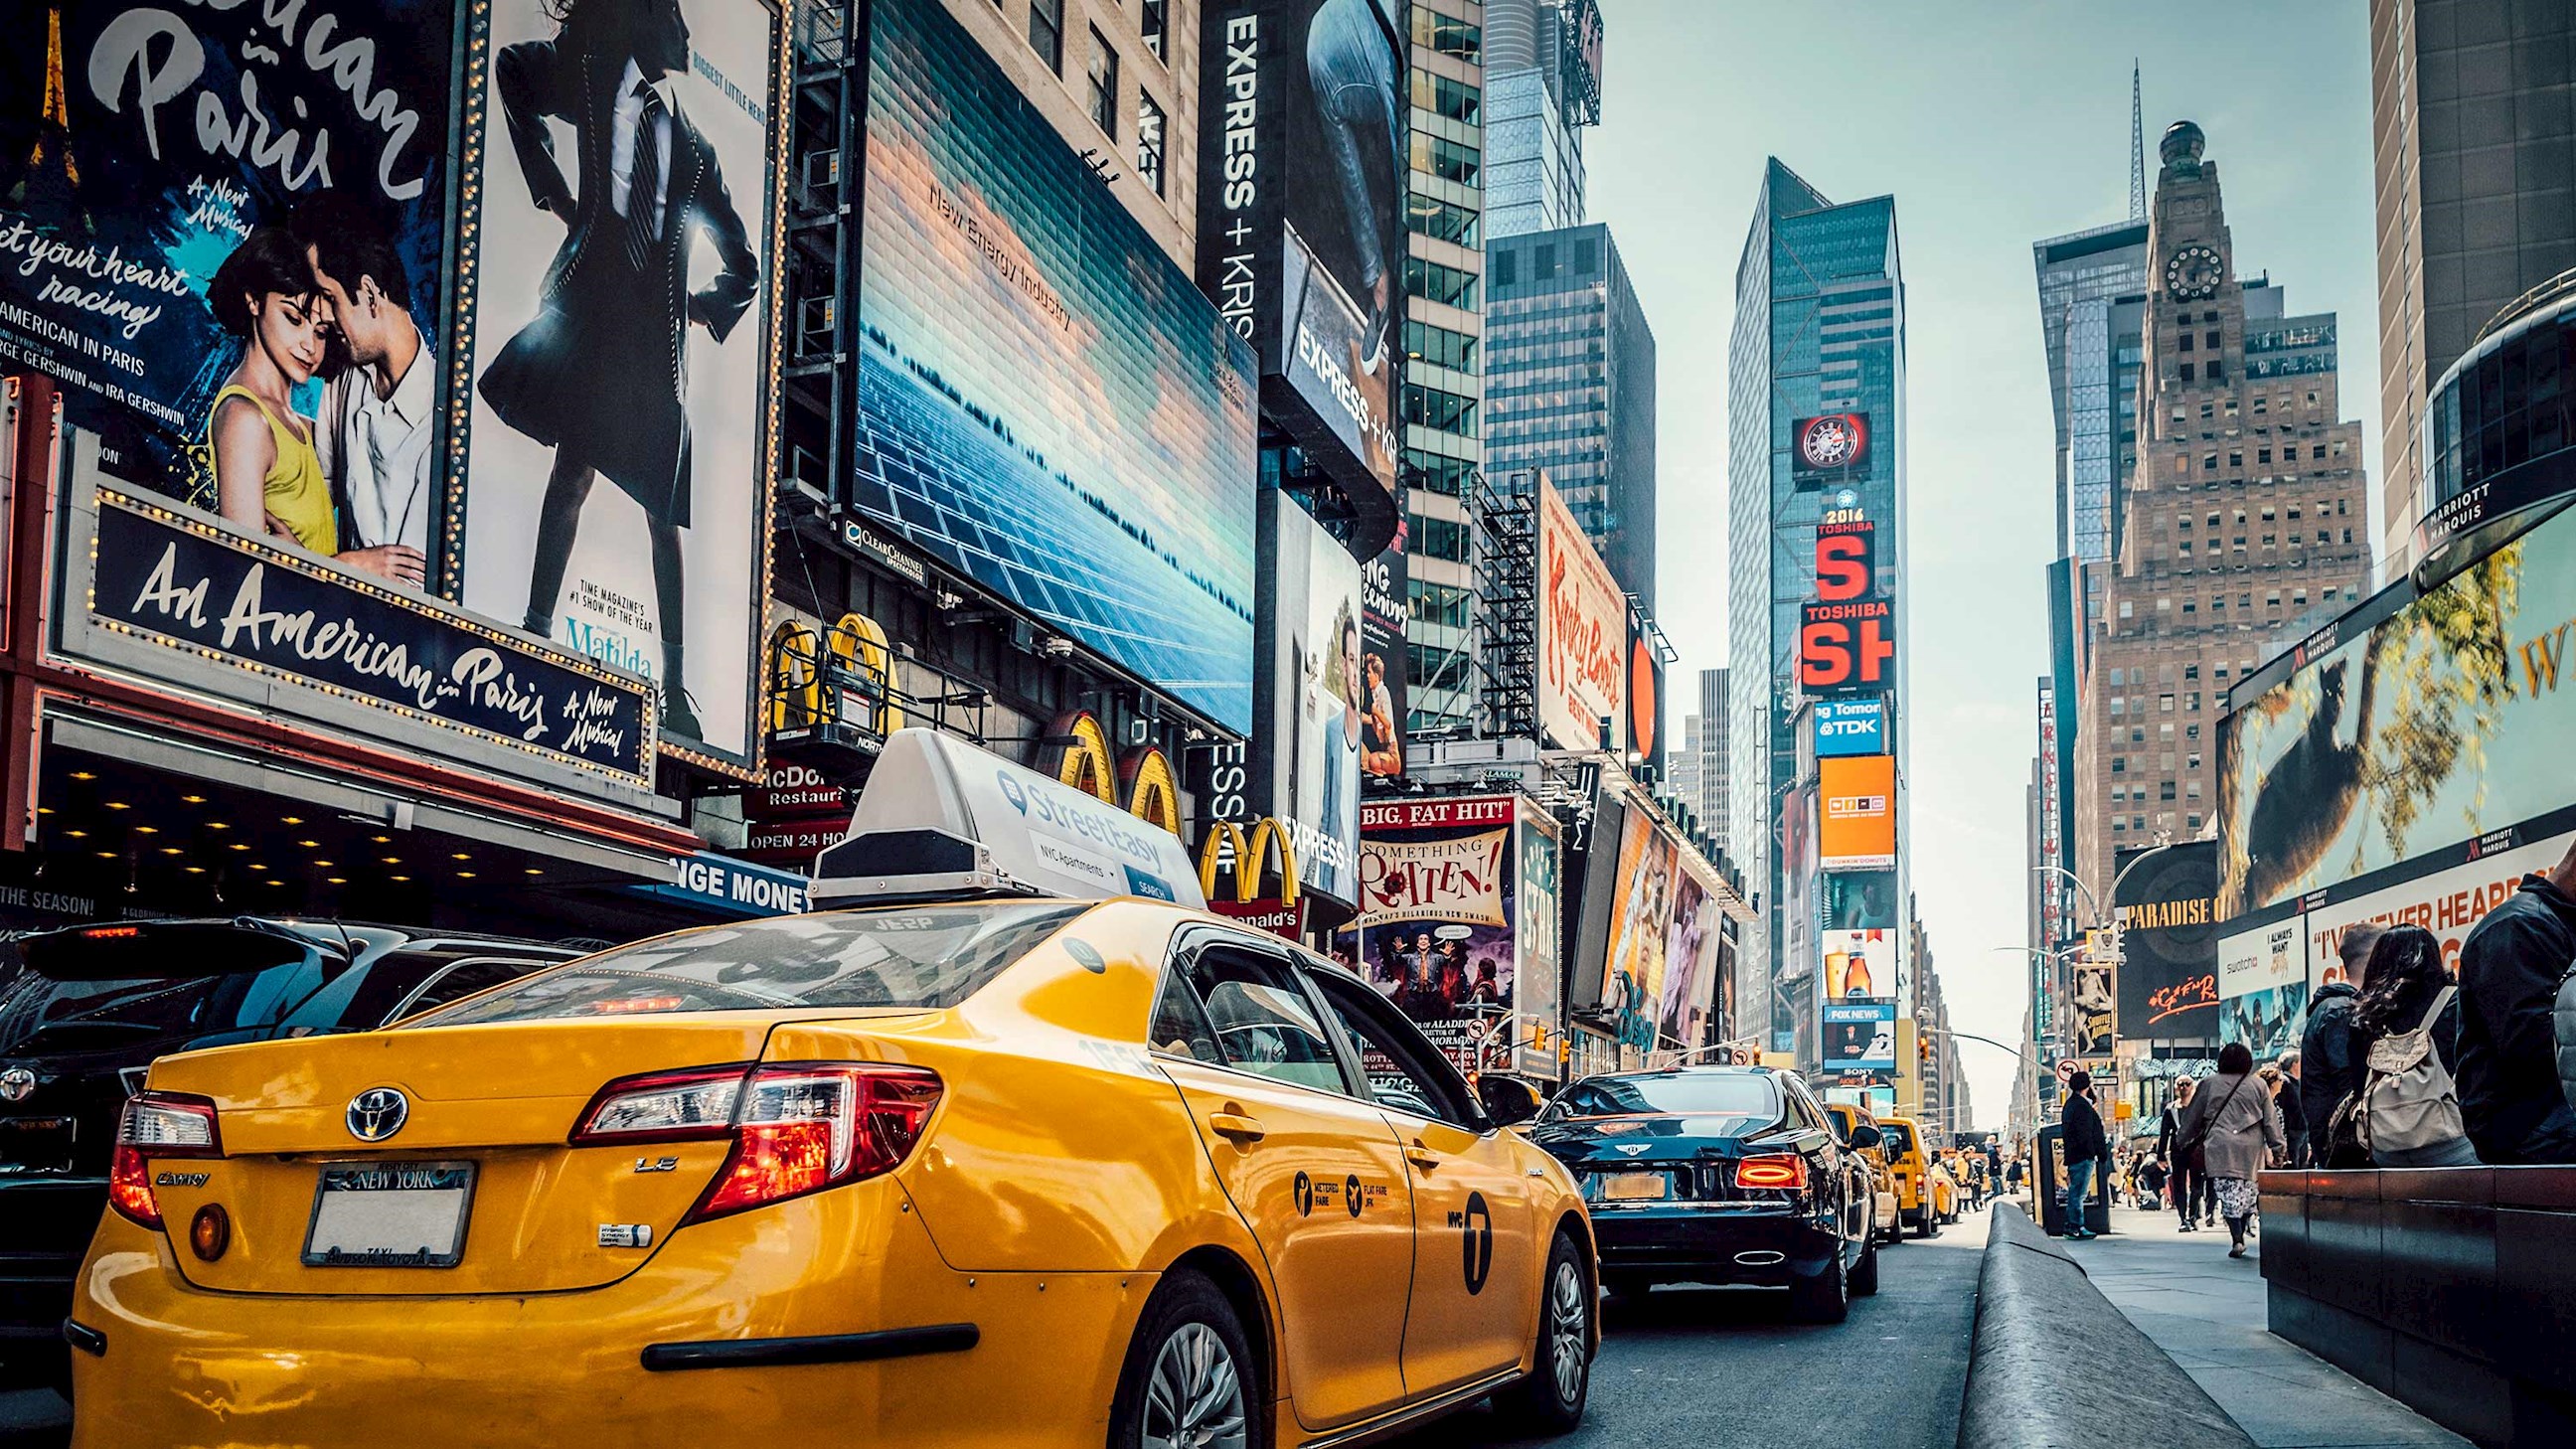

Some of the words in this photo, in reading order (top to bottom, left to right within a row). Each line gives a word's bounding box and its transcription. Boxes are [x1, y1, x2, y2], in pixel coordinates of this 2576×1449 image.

[241, 27, 280, 67] in
[693, 51, 724, 89] BIGGEST
[724, 80, 747, 111] LITTLE
[1223, 14, 1259, 211] EXPRESS
[187, 174, 206, 195] A
[204, 177, 250, 208] New
[186, 202, 255, 241] Musical
[0, 213, 33, 253] et
[18, 236, 103, 277] your
[102, 245, 191, 297] heart
[928, 184, 963, 231] New
[966, 216, 1017, 283] Energy
[1020, 266, 1071, 332] Industry
[37, 273, 162, 341] racing
[0, 301, 80, 350] AMERICAN
[82, 336, 99, 359] IN
[102, 344, 146, 378] PARIS
[43, 346, 56, 358] BY
[23, 349, 87, 388] GERSHWIN
[87, 380, 104, 395] AND
[105, 383, 125, 403] IRA
[127, 393, 186, 427] GERSHWIN
[1298, 320, 1370, 433] EXPRESS
[1826, 508, 1864, 525] 2016
[2429, 482, 2491, 527] MARRIOTT
[1818, 522, 1874, 535] TOSHIBA
[2430, 504, 2483, 541] MARQUIS
[886, 556, 924, 582] SPECTACOLOR
[1816, 535, 1867, 601] S
[579, 578, 598, 597] TIME
[600, 587, 645, 616] MAGAZINE'S
[569, 590, 579, 604] #1
[582, 594, 605, 614] SHOW
[607, 605, 617, 619] OF
[619, 609, 633, 626] THE
[635, 615, 653, 634] YEAR
[1547, 527, 1590, 697] Kinky
[1587, 615, 1621, 711] Boots
[1807, 602, 1888, 621] TOSHIBA
[131, 540, 209, 629] An
[220, 562, 435, 710] American
[435, 677, 460, 700] in
[450, 647, 550, 740] Paris
[2306, 621, 2339, 647] MARRIOTT
[564, 615, 653, 681] Matilda
[2307, 636, 2336, 660] MARQUIS
[563, 690, 578, 719] A
[577, 685, 618, 722] New
[1568, 694, 1586, 726] BEST
[561, 719, 624, 758] Musical
[1833, 720, 1876, 735] TDK
[1488, 769, 1523, 780] LAMAR
[1361, 806, 1404, 827] BIG,
[1408, 805, 1451, 823] FAT
[750, 835, 793, 850] OPEN
[798, 834, 818, 848] 24
[1027, 783, 1164, 876] StreetEasy
[2481, 828, 2513, 845] MARRIOTT
[1282, 813, 1346, 872] EXPRESS
[1365, 838, 1484, 859] SOMETHING
[2481, 840, 2510, 855] MARQUIS
[1040, 844, 1058, 862] NYC
[1058, 852, 1104, 879] Apartments
[0, 886, 28, 906] THE
[33, 890, 94, 916] SEASON!
[1139, 881, 1166, 899] SEARCH
[2306, 889, 2328, 902] MARRIOTT
[2126, 897, 2210, 930] PARADISE
[2306, 899, 2326, 911] MARQUIS
[2270, 927, 2293, 944] ALWAYS
[2272, 941, 2289, 955] WANT
[2226, 955, 2252, 975] swatch
[1832, 1010, 1852, 1020] FOX
[1852, 1009, 1879, 1020] NEWS
[2088, 1014, 2112, 1031] SHUFFLE
[2092, 1026, 2112, 1041] ALONG
[633, 1156, 679, 1174] LE
[356, 1171, 393, 1190] NEW
[396, 1171, 435, 1190] YORK
[1314, 1182, 1340, 1194] METERED
[1364, 1185, 1374, 1196] FLAT
[1375, 1186, 1387, 1197] FARE
[1315, 1196, 1330, 1208] FARE
[1365, 1198, 1374, 1208] JFK
[1447, 1210, 1463, 1229] NYC
[326, 1253, 376, 1265] HUDSON
[381, 1253, 426, 1265] TOYOTA
